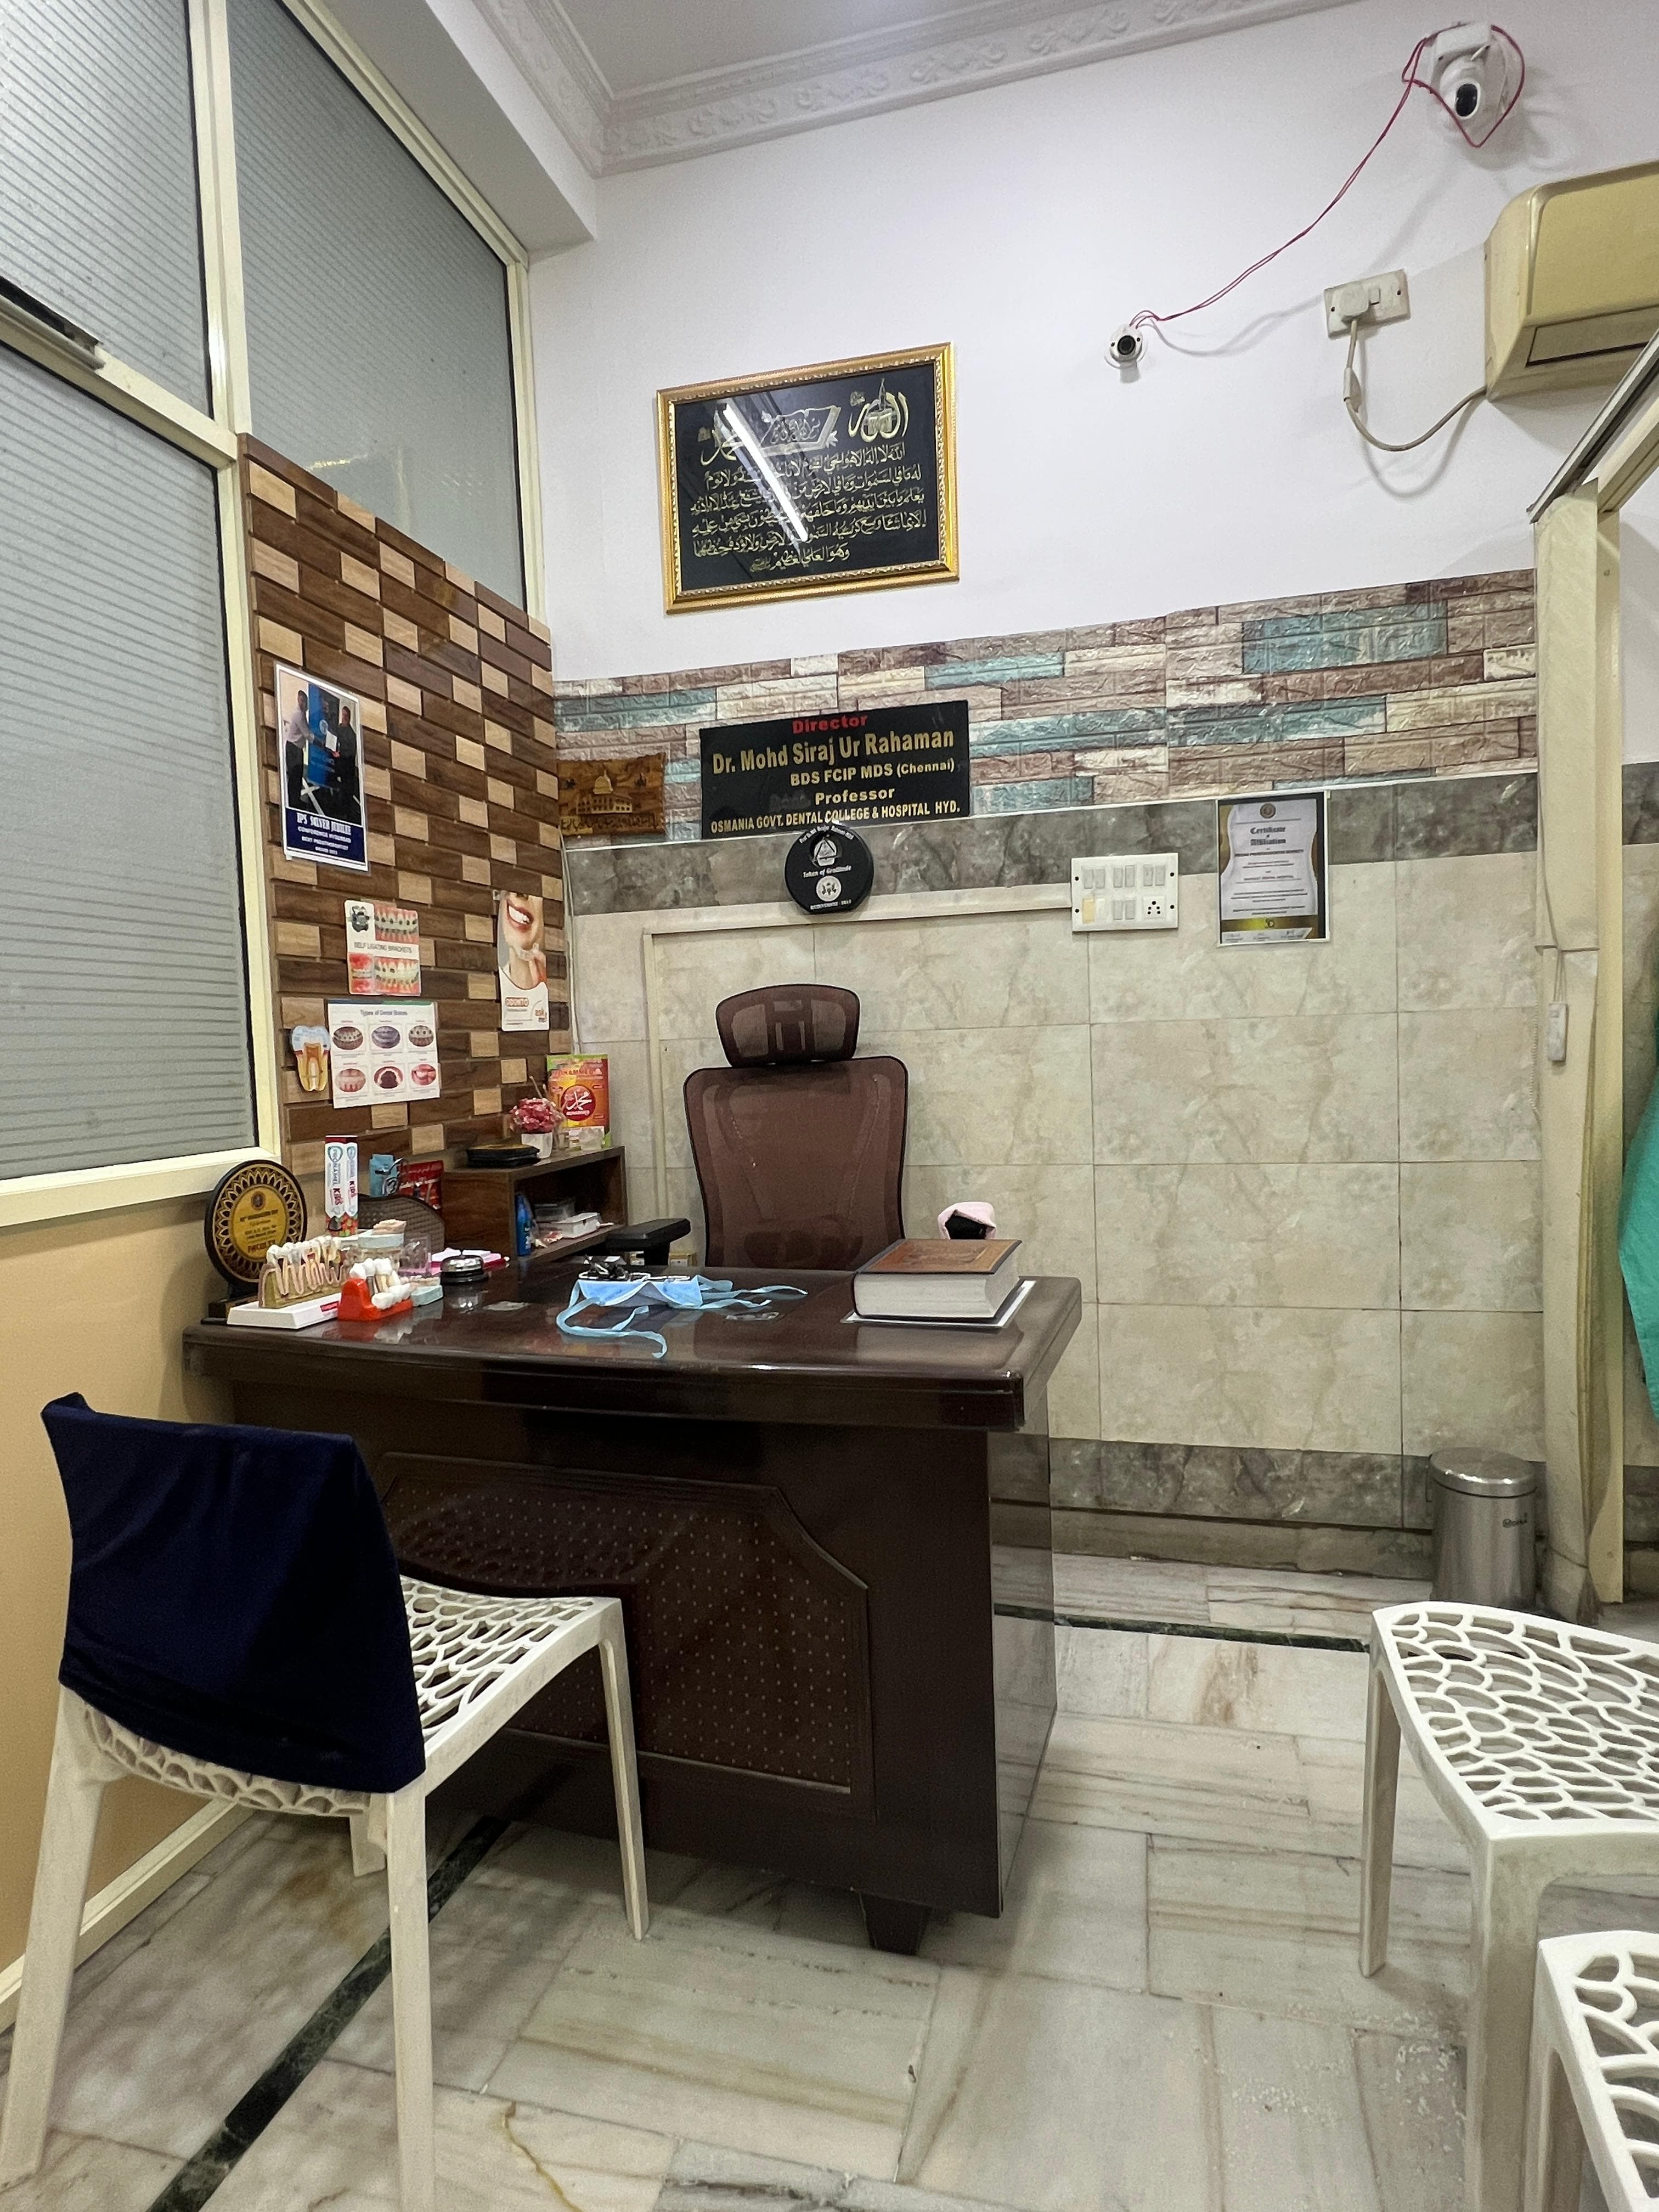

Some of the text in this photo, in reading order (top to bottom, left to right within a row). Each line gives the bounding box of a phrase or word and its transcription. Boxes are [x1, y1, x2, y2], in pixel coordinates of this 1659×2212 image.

[792, 715, 868, 734] Director
[713, 730, 953, 774] Dr. Mohd Siraj Ur Rahaman
[791, 758, 955, 786] BDS FCIP MDS (Chennai)
[815, 788, 895, 805] Professor
[711, 800, 960, 833] OSMANIA GOVT. DENTAL COLLEGE & HOSPITAL HYD.
